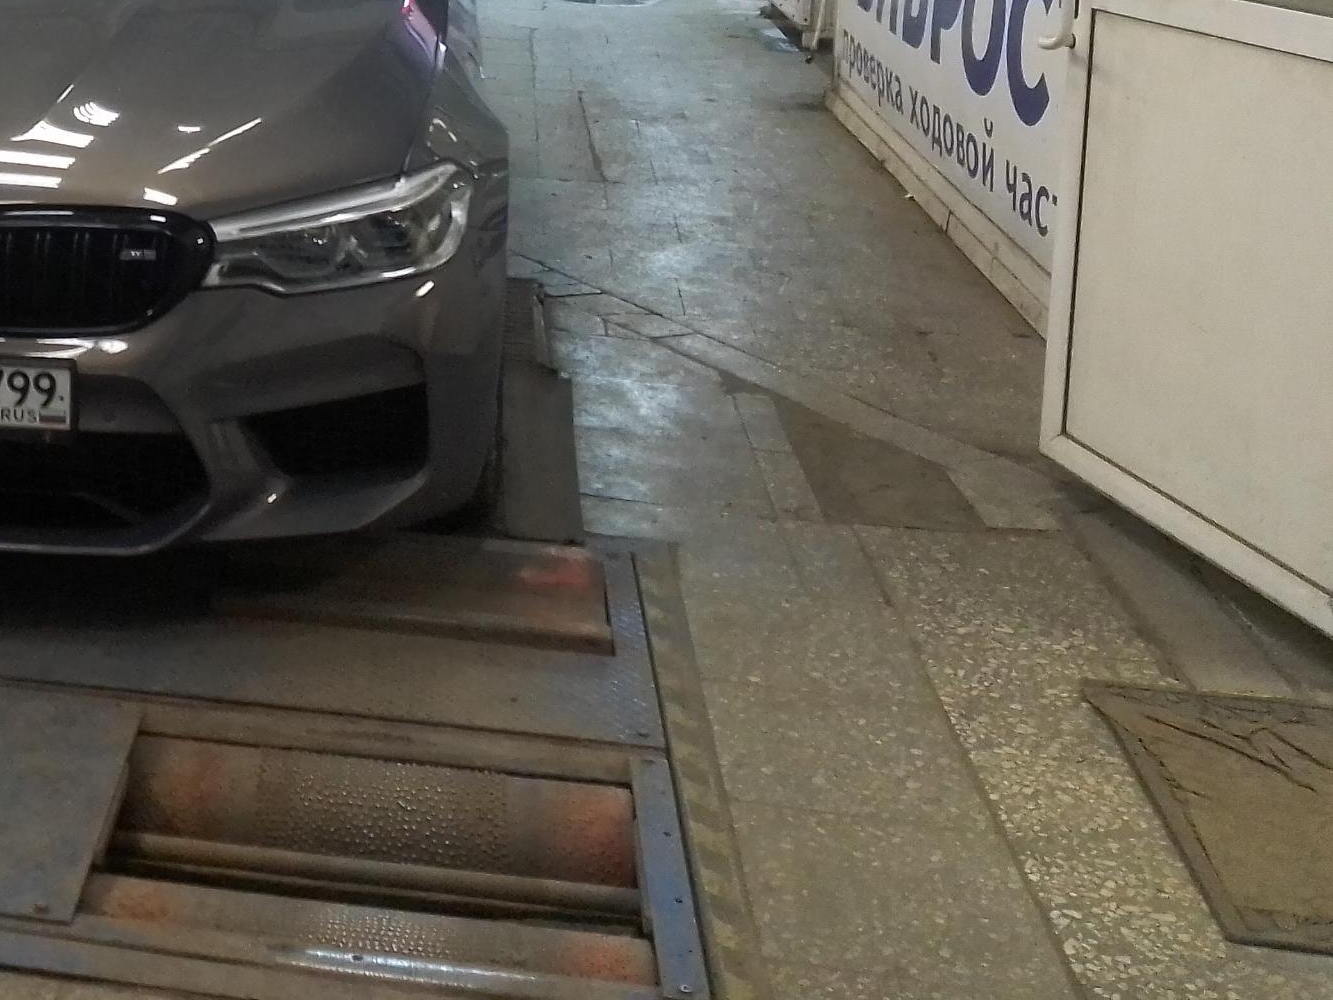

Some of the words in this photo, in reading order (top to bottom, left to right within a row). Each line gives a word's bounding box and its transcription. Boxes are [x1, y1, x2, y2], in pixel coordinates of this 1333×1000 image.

[842, 29, 905, 116] проверка
[909, 84, 995, 193] ходовой
[1005, 159, 1058, 239] час
[0, 406, 37, 424] RUS
